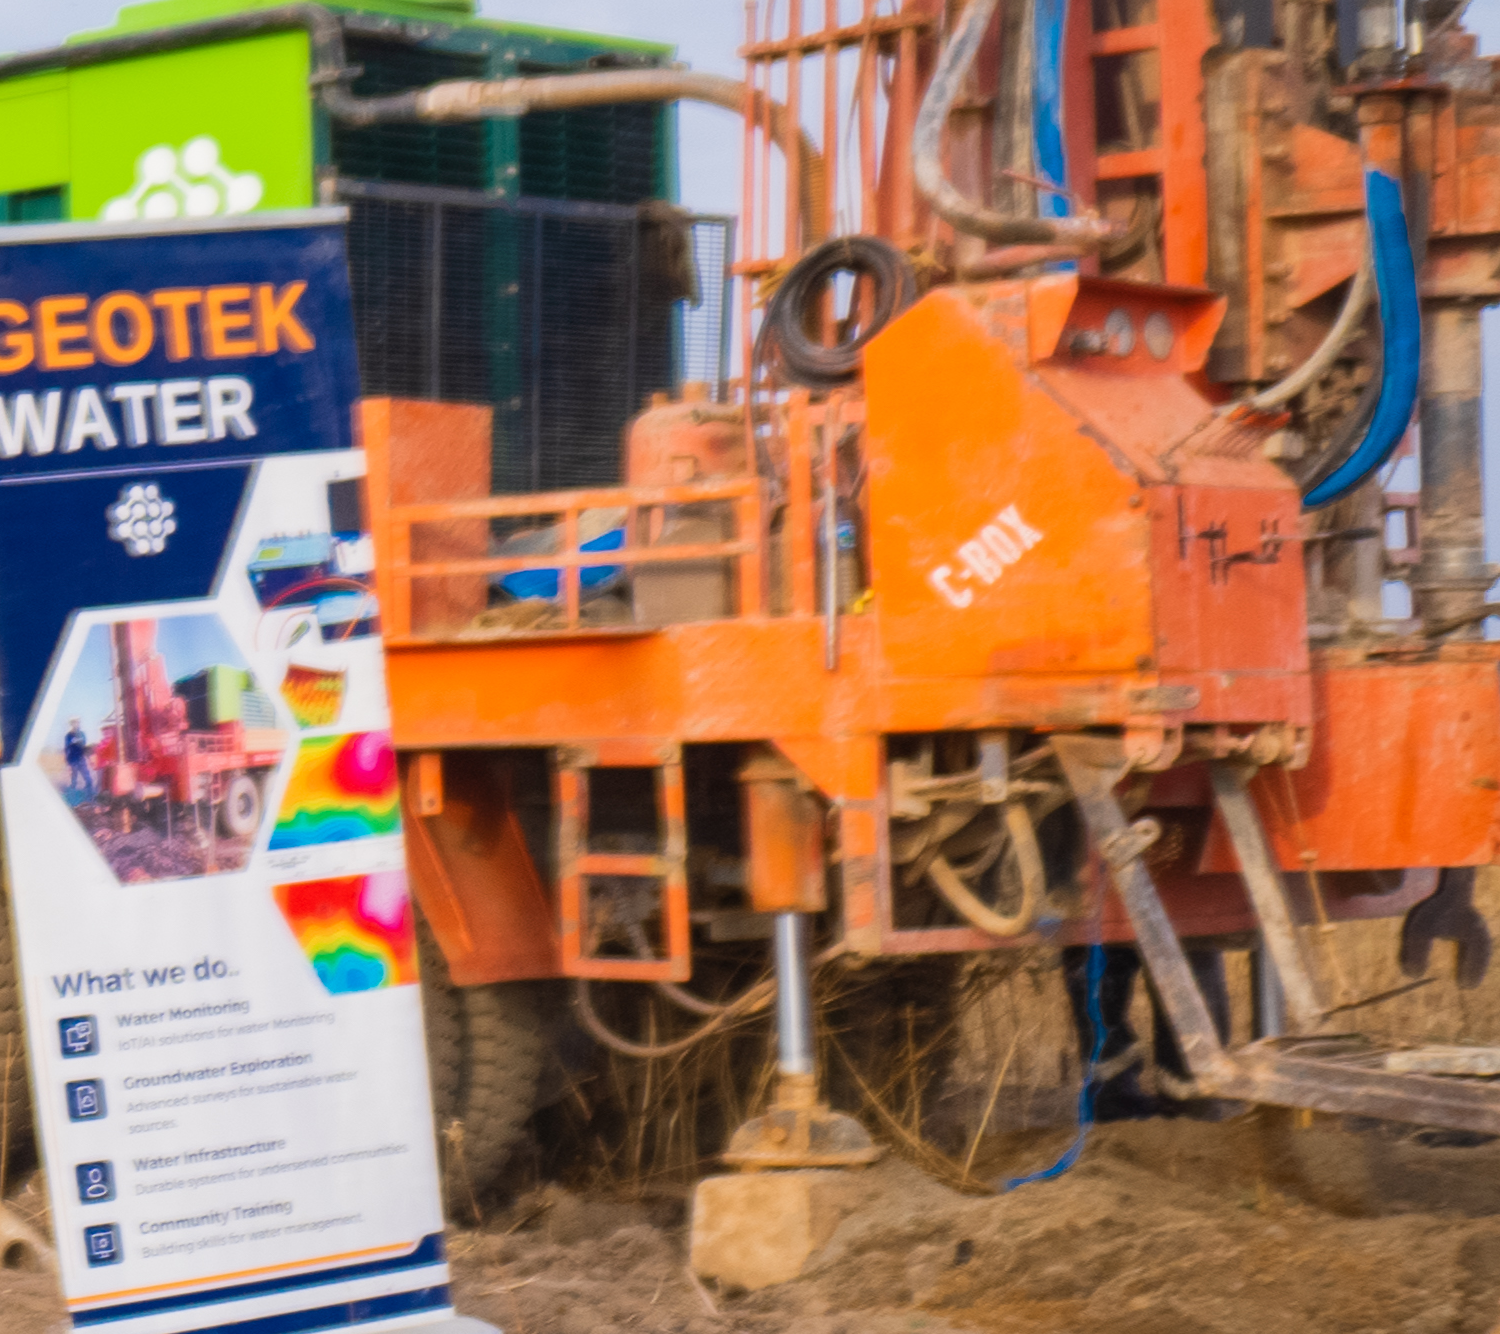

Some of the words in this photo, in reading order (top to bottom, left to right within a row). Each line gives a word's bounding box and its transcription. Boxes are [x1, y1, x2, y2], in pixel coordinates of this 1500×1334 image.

[930, 503, 1044, 609] C-BOX
[52, 967, 136, 999] What
[144, 964, 186, 988] we
[116, 1010, 165, 1028] Water
[168, 998, 251, 1020] Monitoring
[123, 1063, 227, 1092] Groundwater
[230, 1050, 314, 1075] Exploration
[134, 1154, 181, 1172] Water
[183, 1137, 287, 1165] Infrastructure
[139, 1208, 230, 1235] Community
[232, 1198, 294, 1220] Training
